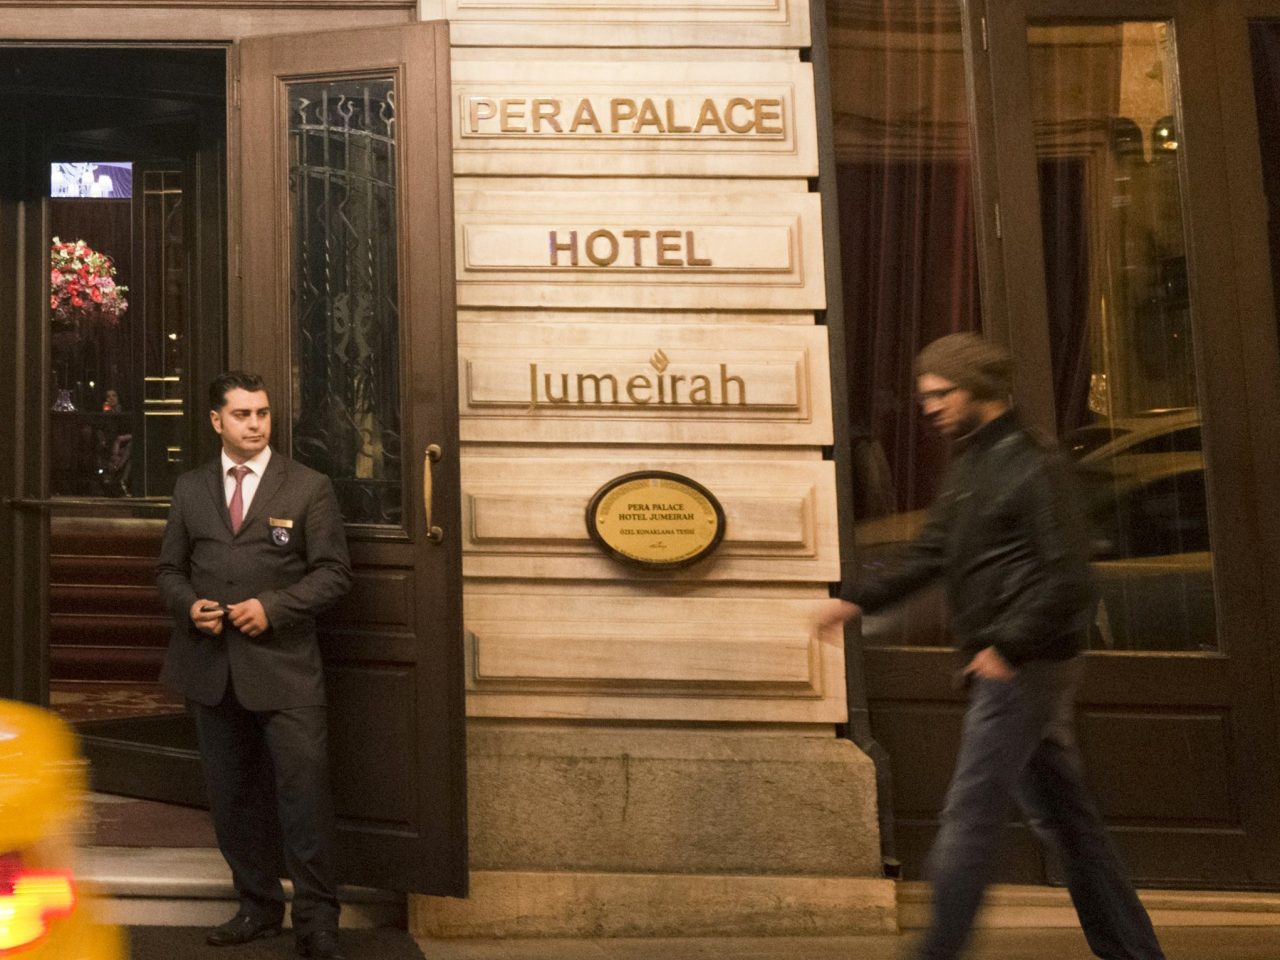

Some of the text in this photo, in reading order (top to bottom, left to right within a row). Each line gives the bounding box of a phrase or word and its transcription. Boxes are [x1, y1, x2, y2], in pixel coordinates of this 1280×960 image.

[469, 97, 784, 134] PERA PALACE
[549, 229, 713, 267] HOTEL
[527, 348, 747, 415] Jumeirah
[618, 513, 695, 521] HOTEL JUMEIRAH
[627, 503, 685, 511] PERA PALACE
